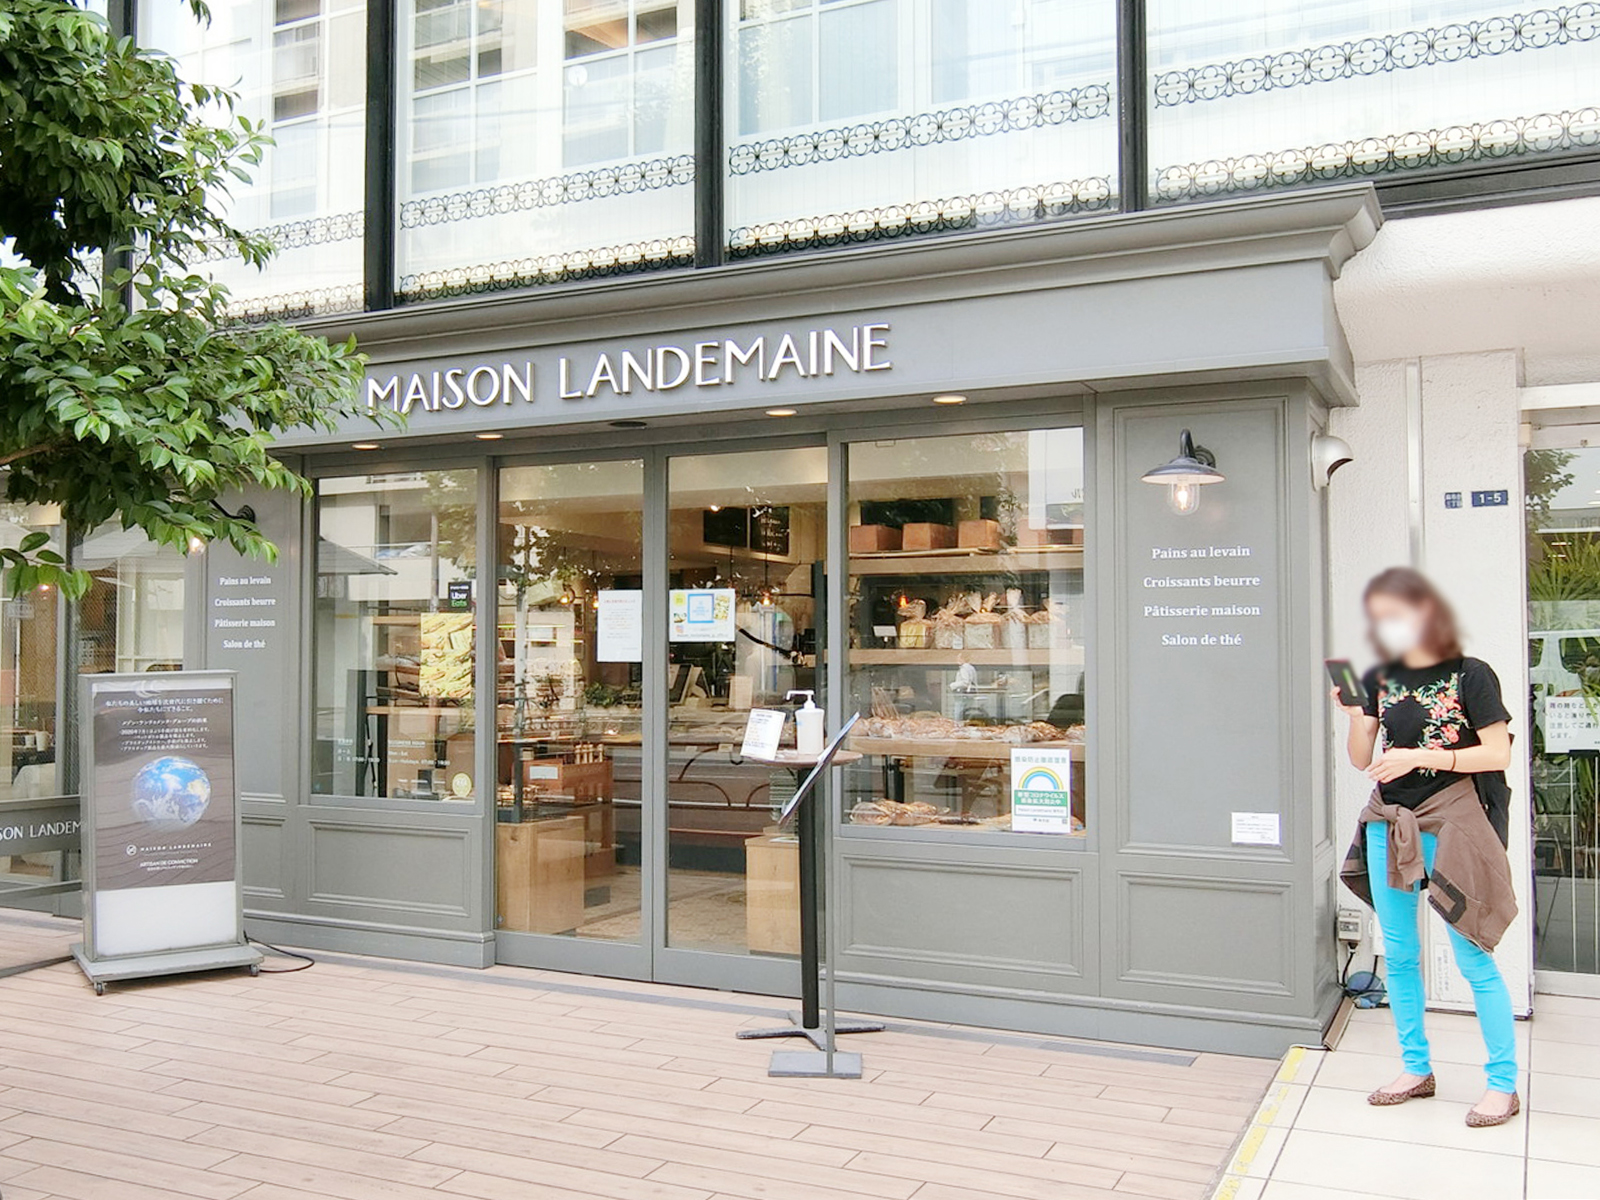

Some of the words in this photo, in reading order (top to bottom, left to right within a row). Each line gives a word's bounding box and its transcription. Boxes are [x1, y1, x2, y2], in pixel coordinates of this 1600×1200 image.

[366, 361, 535, 416] MAISON
[558, 323, 893, 400] LANDEMAINE
[1479, 493, 1502, 504] 1-5
[1152, 547, 1188, 559] Pains
[1190, 548, 1207, 558] au
[1209, 545, 1251, 558] levain
[219, 577, 239, 586] Pains
[249, 576, 272, 585] levain
[1143, 576, 1212, 588] Croissants
[1213, 575, 1261, 587] beurre
[451, 591, 468, 600] Uber
[214, 598, 251, 607] Croissants
[251, 597, 277, 606] beurre
[1143, 605, 1209, 617] Pâtisserie
[1211, 604, 1261, 616] maison
[214, 619, 249, 628] Pâtisserie
[249, 618, 276, 627] maison
[223, 640, 243, 649] Salon
[243, 640, 253, 648] de
[253, 640, 266, 648] thé
[1161, 634, 1198, 646] Salon
[1200, 634, 1217, 645] de
[1220, 633, 1242, 645] thé
